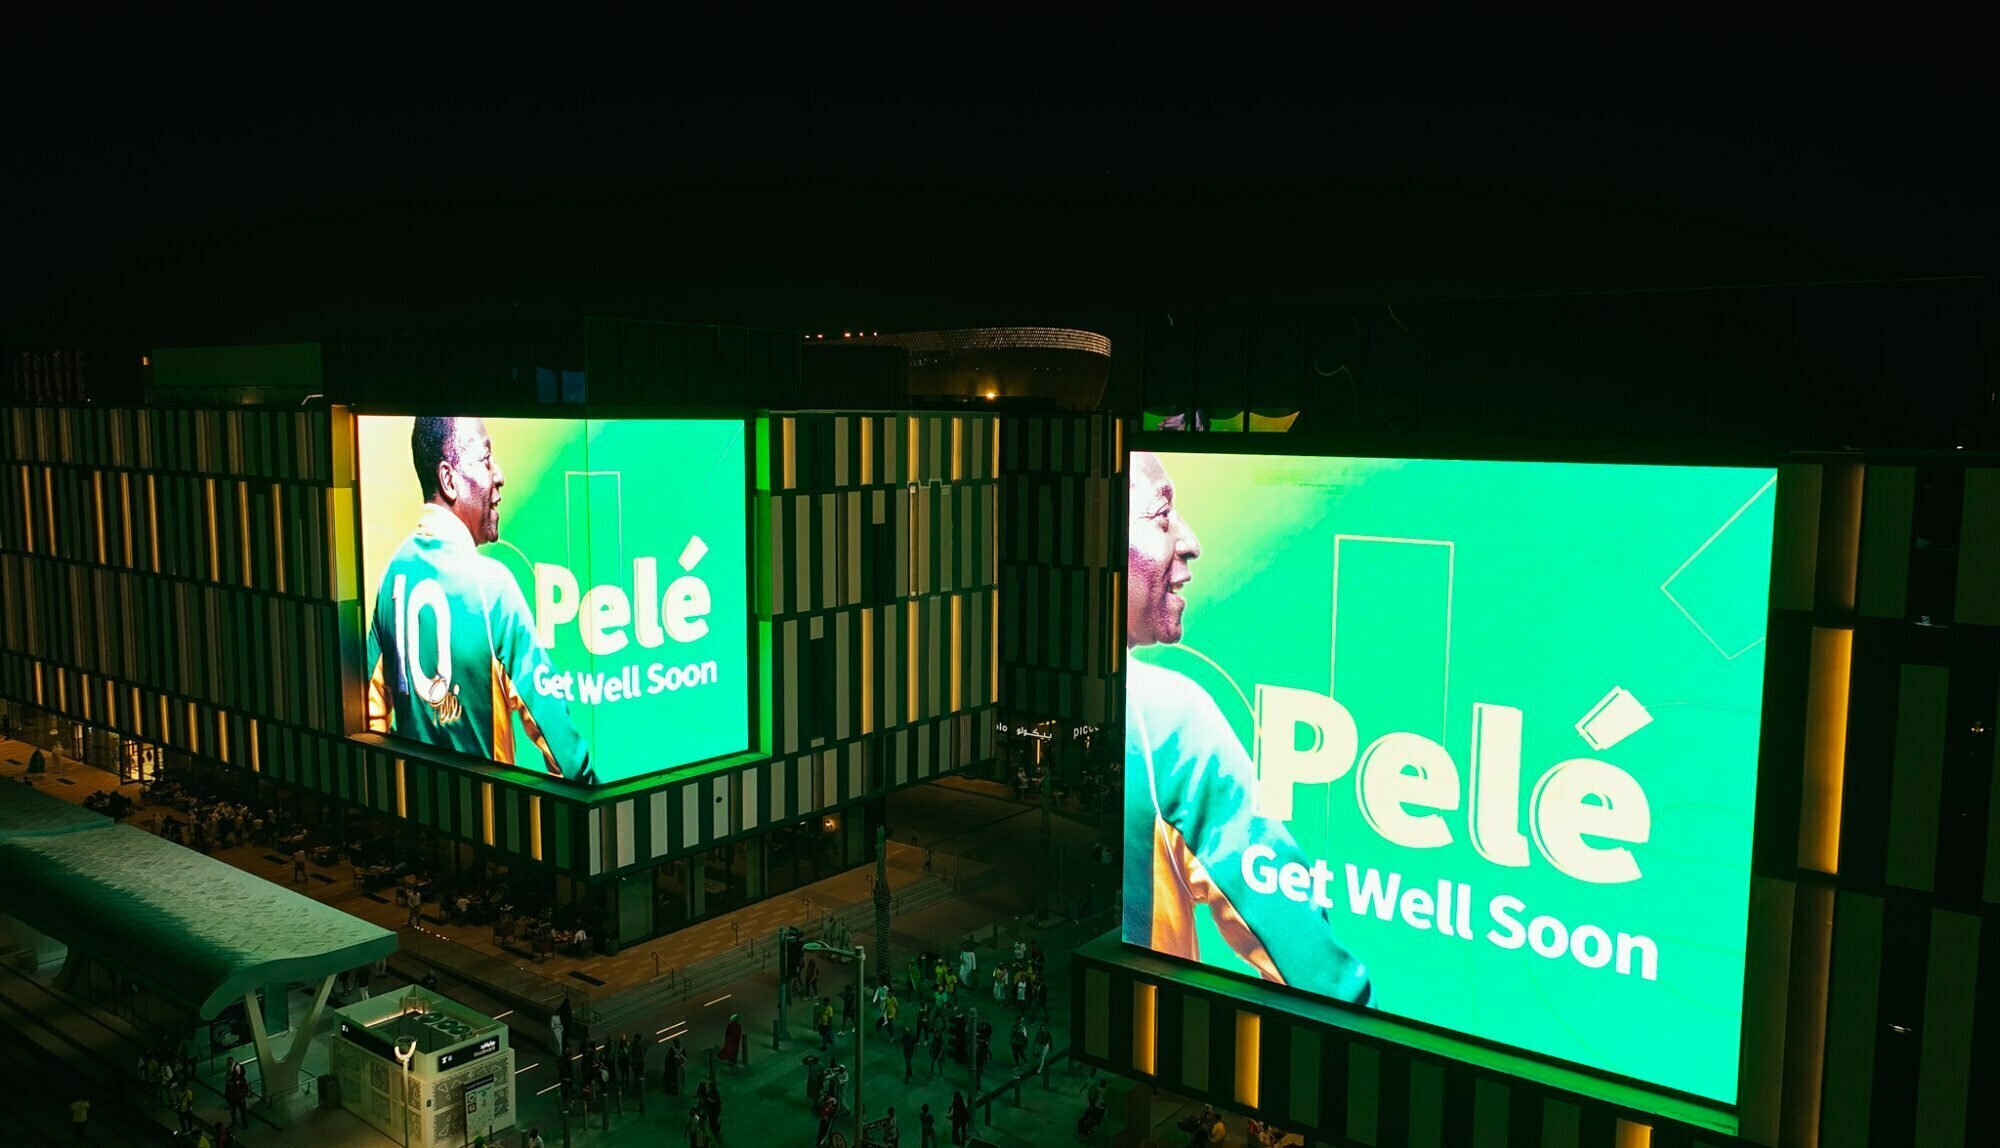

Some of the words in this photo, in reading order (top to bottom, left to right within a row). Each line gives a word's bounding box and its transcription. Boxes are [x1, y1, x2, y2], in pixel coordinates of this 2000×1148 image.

[392, 573, 452, 703] 10
[534, 535, 712, 656] Pelé
[533, 663, 575, 702] Get
[577, 664, 642, 705] Well
[646, 660, 718, 695] Soon
[1253, 684, 1655, 884] Pelé
[1240, 844, 1335, 909] Get
[1344, 862, 1474, 941] Well
[1486, 894, 1659, 981] Soon
